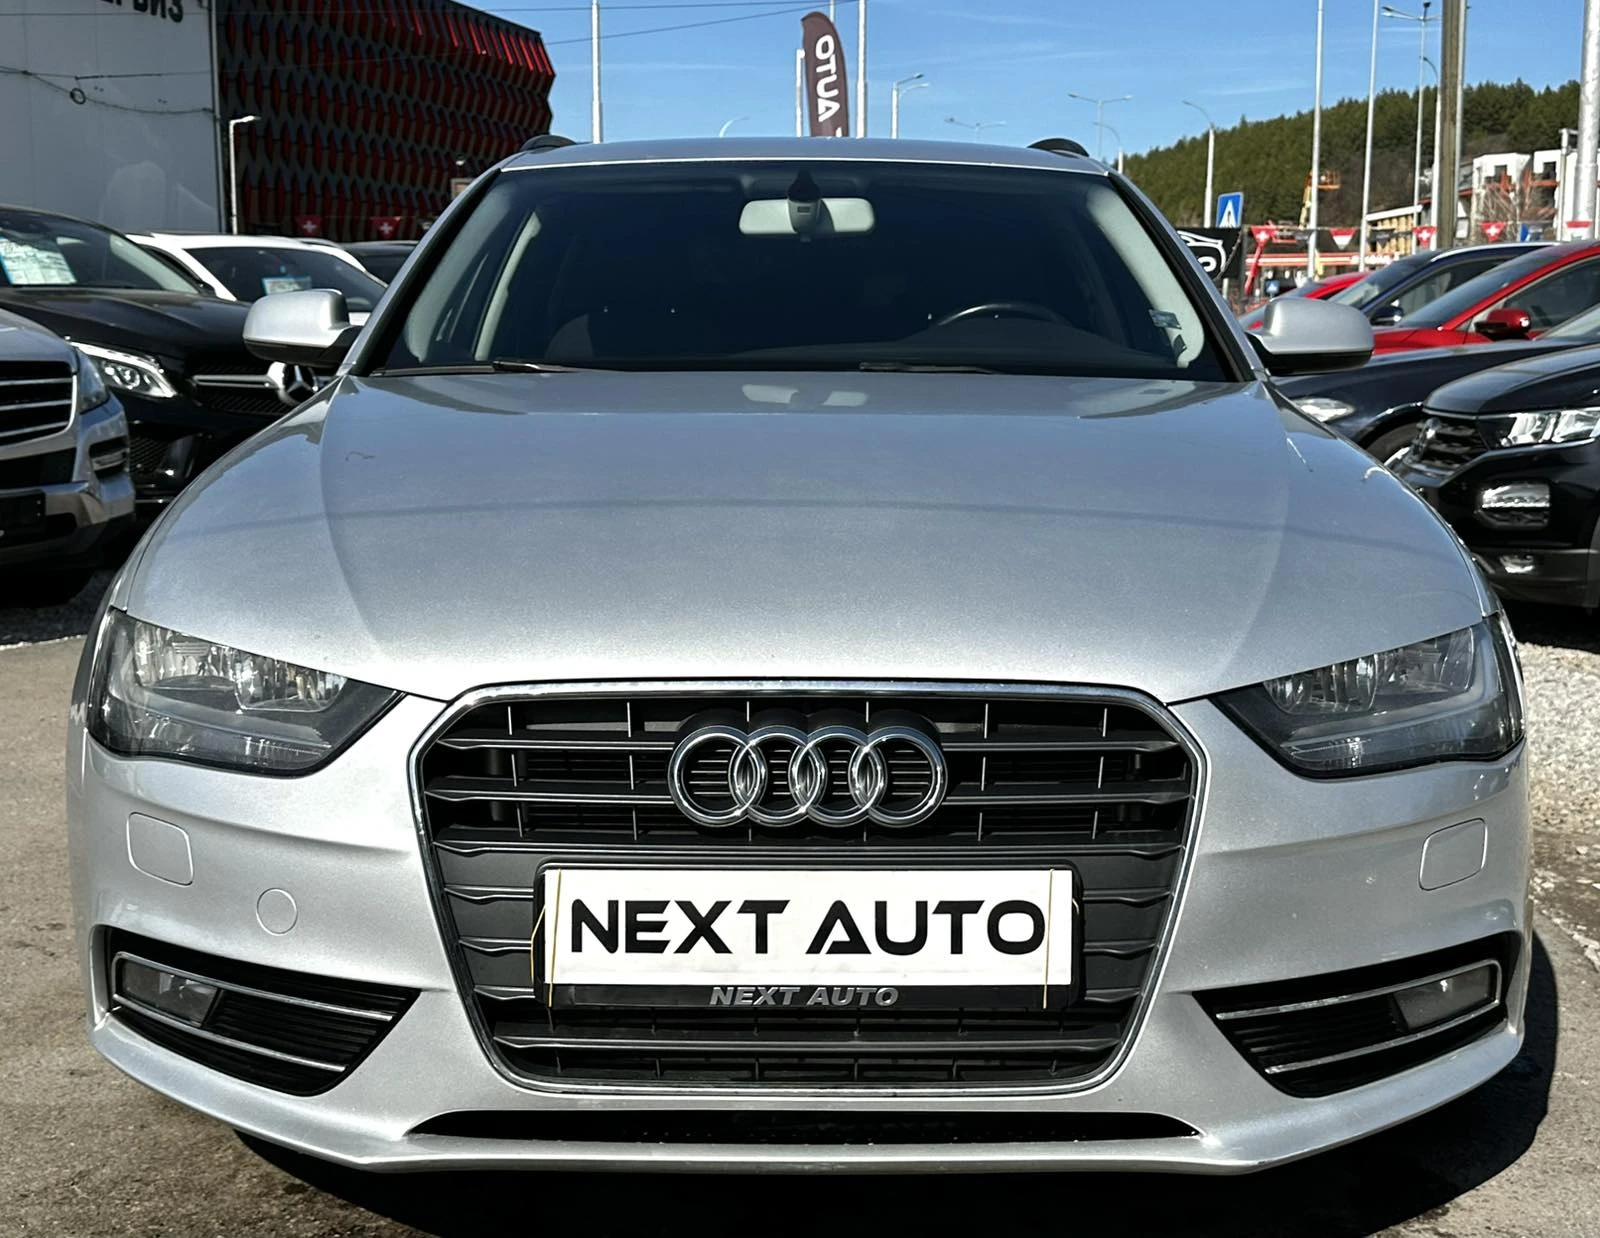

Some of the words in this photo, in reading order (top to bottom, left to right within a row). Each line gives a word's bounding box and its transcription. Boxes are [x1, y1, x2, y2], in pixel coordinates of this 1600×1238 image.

[571, 898, 790, 954] NEXT
[805, 899, 1046, 956] AUTO
[708, 986, 801, 1006] NEXT
[805, 986, 900, 1007] AUTO
